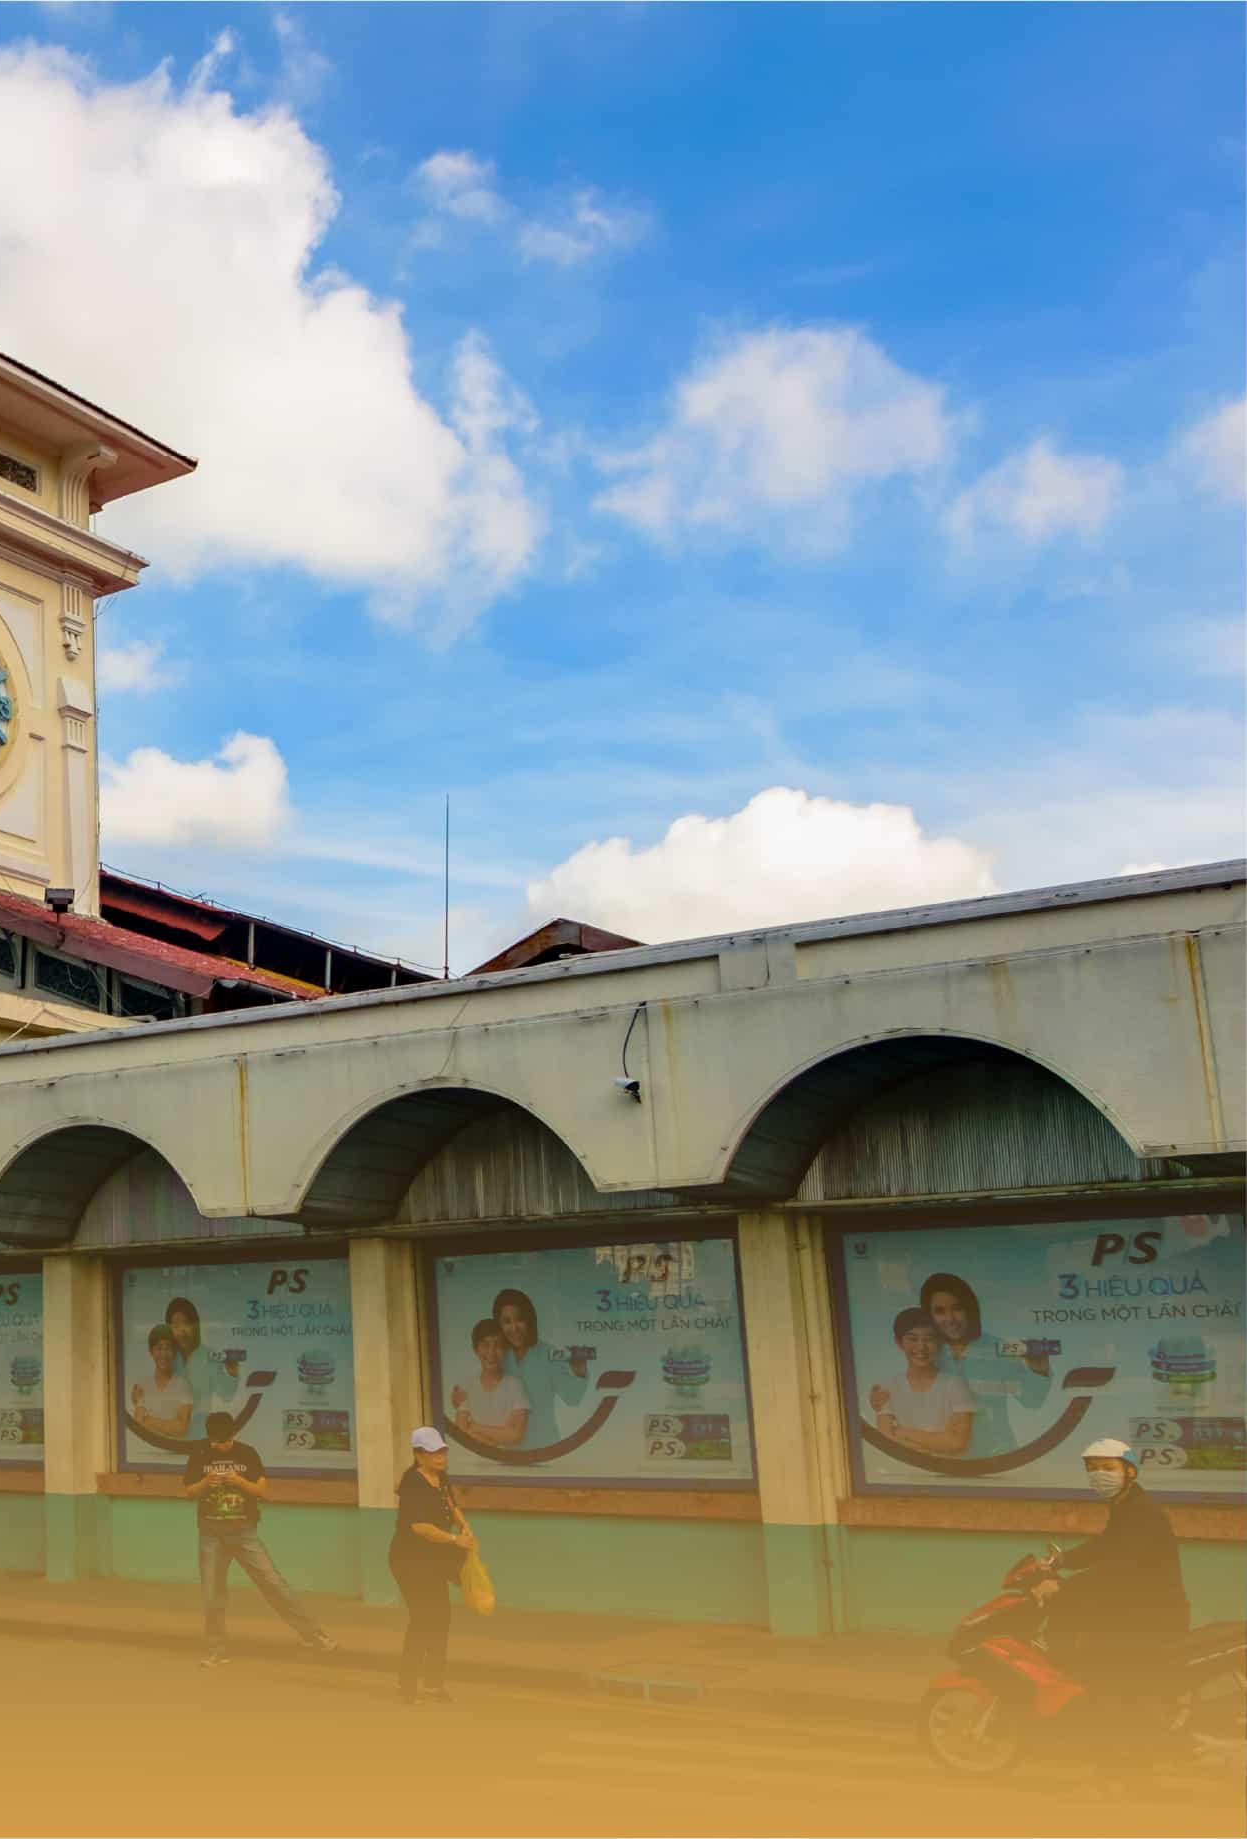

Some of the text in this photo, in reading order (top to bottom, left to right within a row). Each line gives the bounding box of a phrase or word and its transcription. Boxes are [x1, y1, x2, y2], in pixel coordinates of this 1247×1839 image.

[1058, 1273, 1080, 1300] 3
[595, 1289, 612, 1313] 3
[577, 1319, 624, 1333] TRONG
[1033, 1307, 1095, 1325] TRONG
